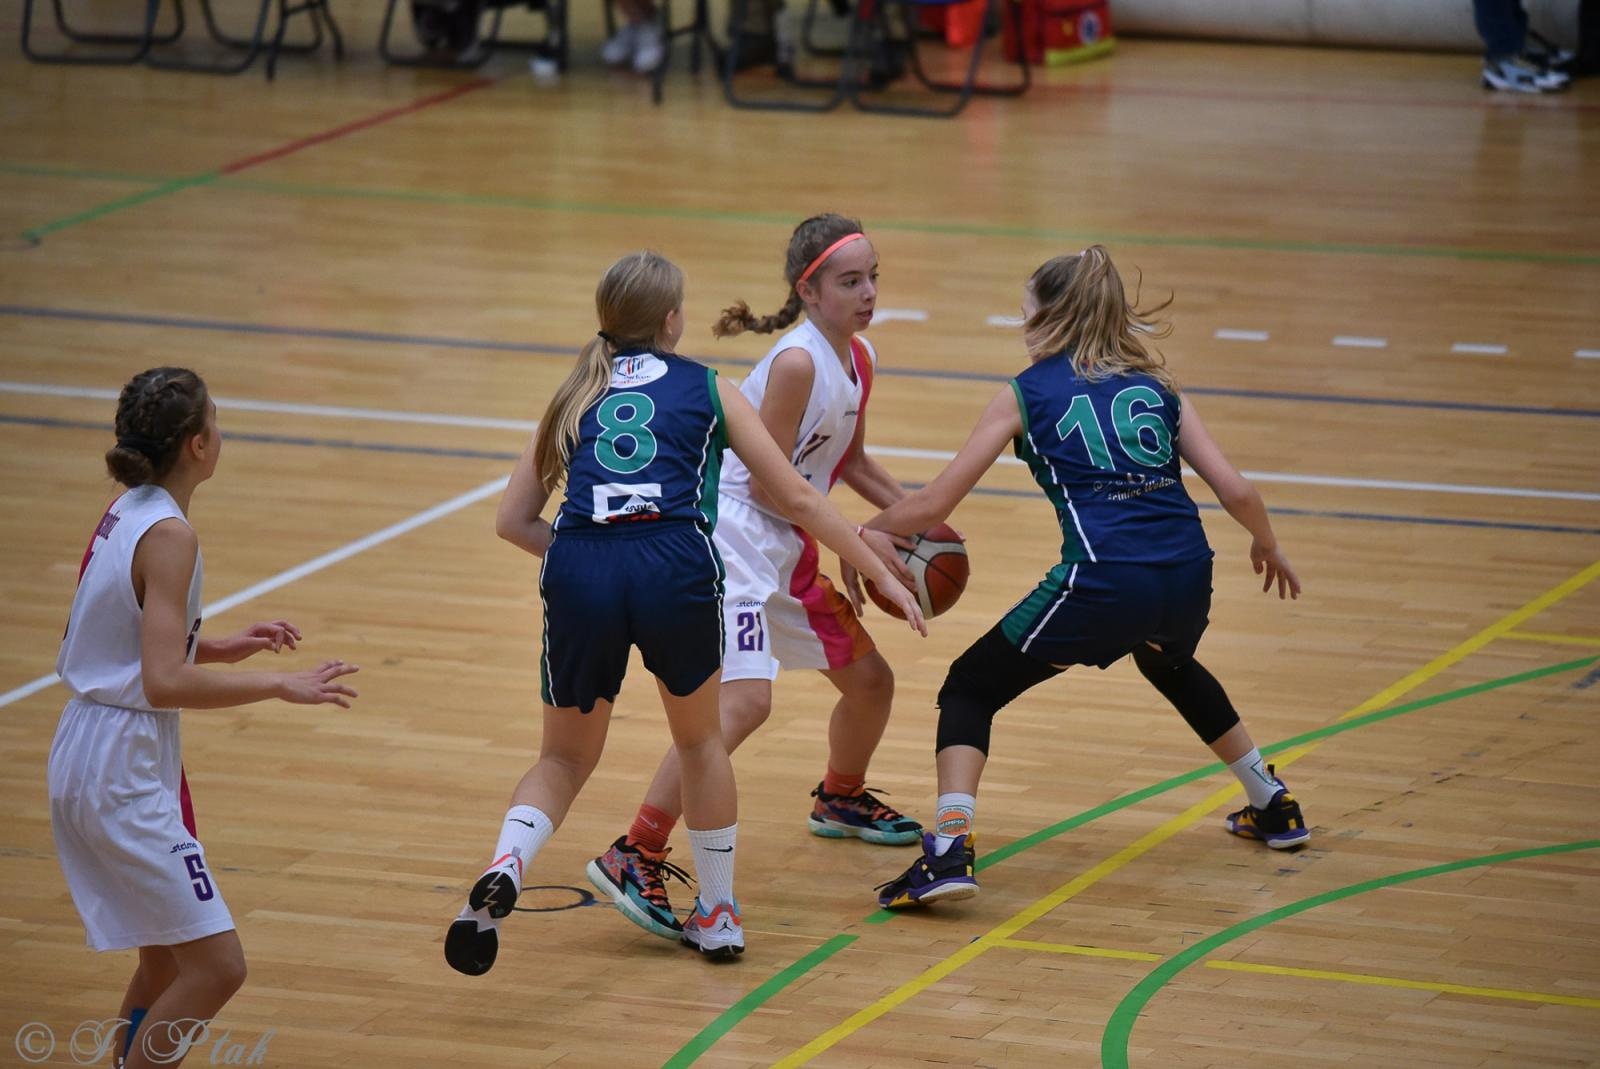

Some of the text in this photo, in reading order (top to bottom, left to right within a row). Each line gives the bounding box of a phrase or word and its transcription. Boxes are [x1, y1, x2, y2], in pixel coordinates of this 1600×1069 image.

[594, 391, 657, 474] 8
[1056, 385, 1172, 471] 16
[737, 611, 764, 652] 21
[183, 853, 214, 902] 5
